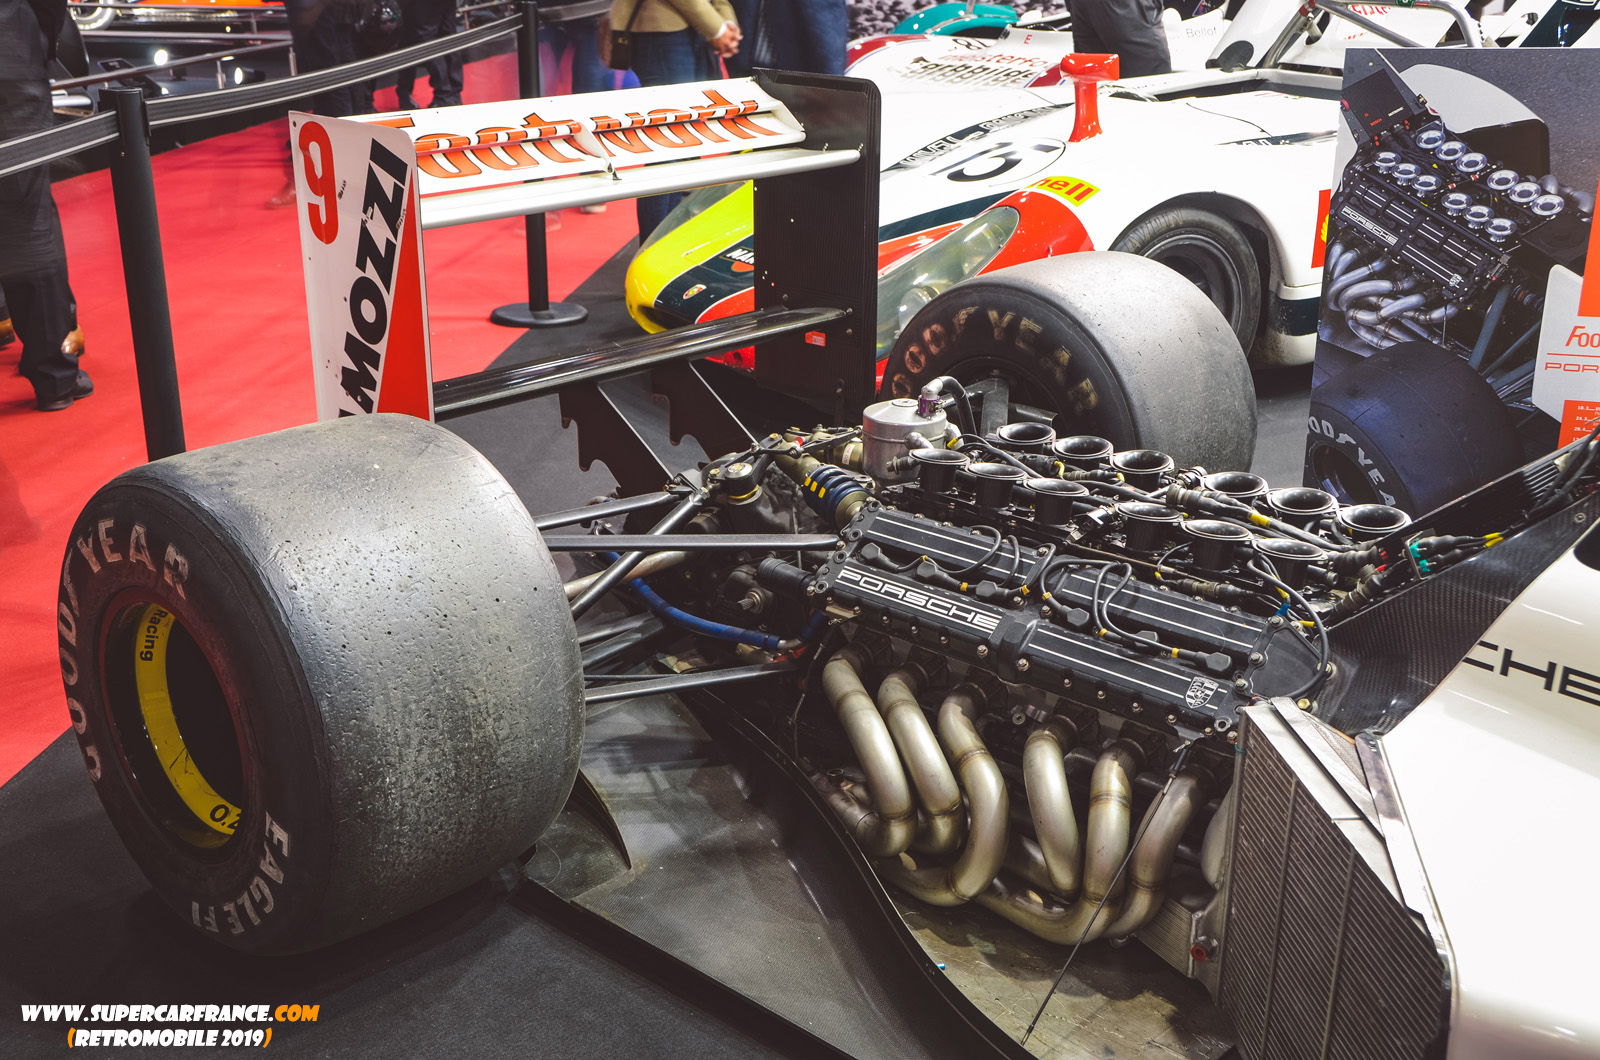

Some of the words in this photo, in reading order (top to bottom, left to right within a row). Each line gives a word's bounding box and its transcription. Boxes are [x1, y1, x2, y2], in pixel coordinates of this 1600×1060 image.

[360, 89, 784, 179] ootwork
[299, 121, 339, 245] 9
[1035, 176, 1095, 203] hell
[1340, 206, 1399, 245] PORSCHE
[338, 137, 409, 418] MOZZI
[139, 608, 169, 662] Racing
[837, 568, 1001, 630] PORSCHE
[57, 519, 190, 782] GOODYEAR
[222, 811, 289, 935] EAGLE
